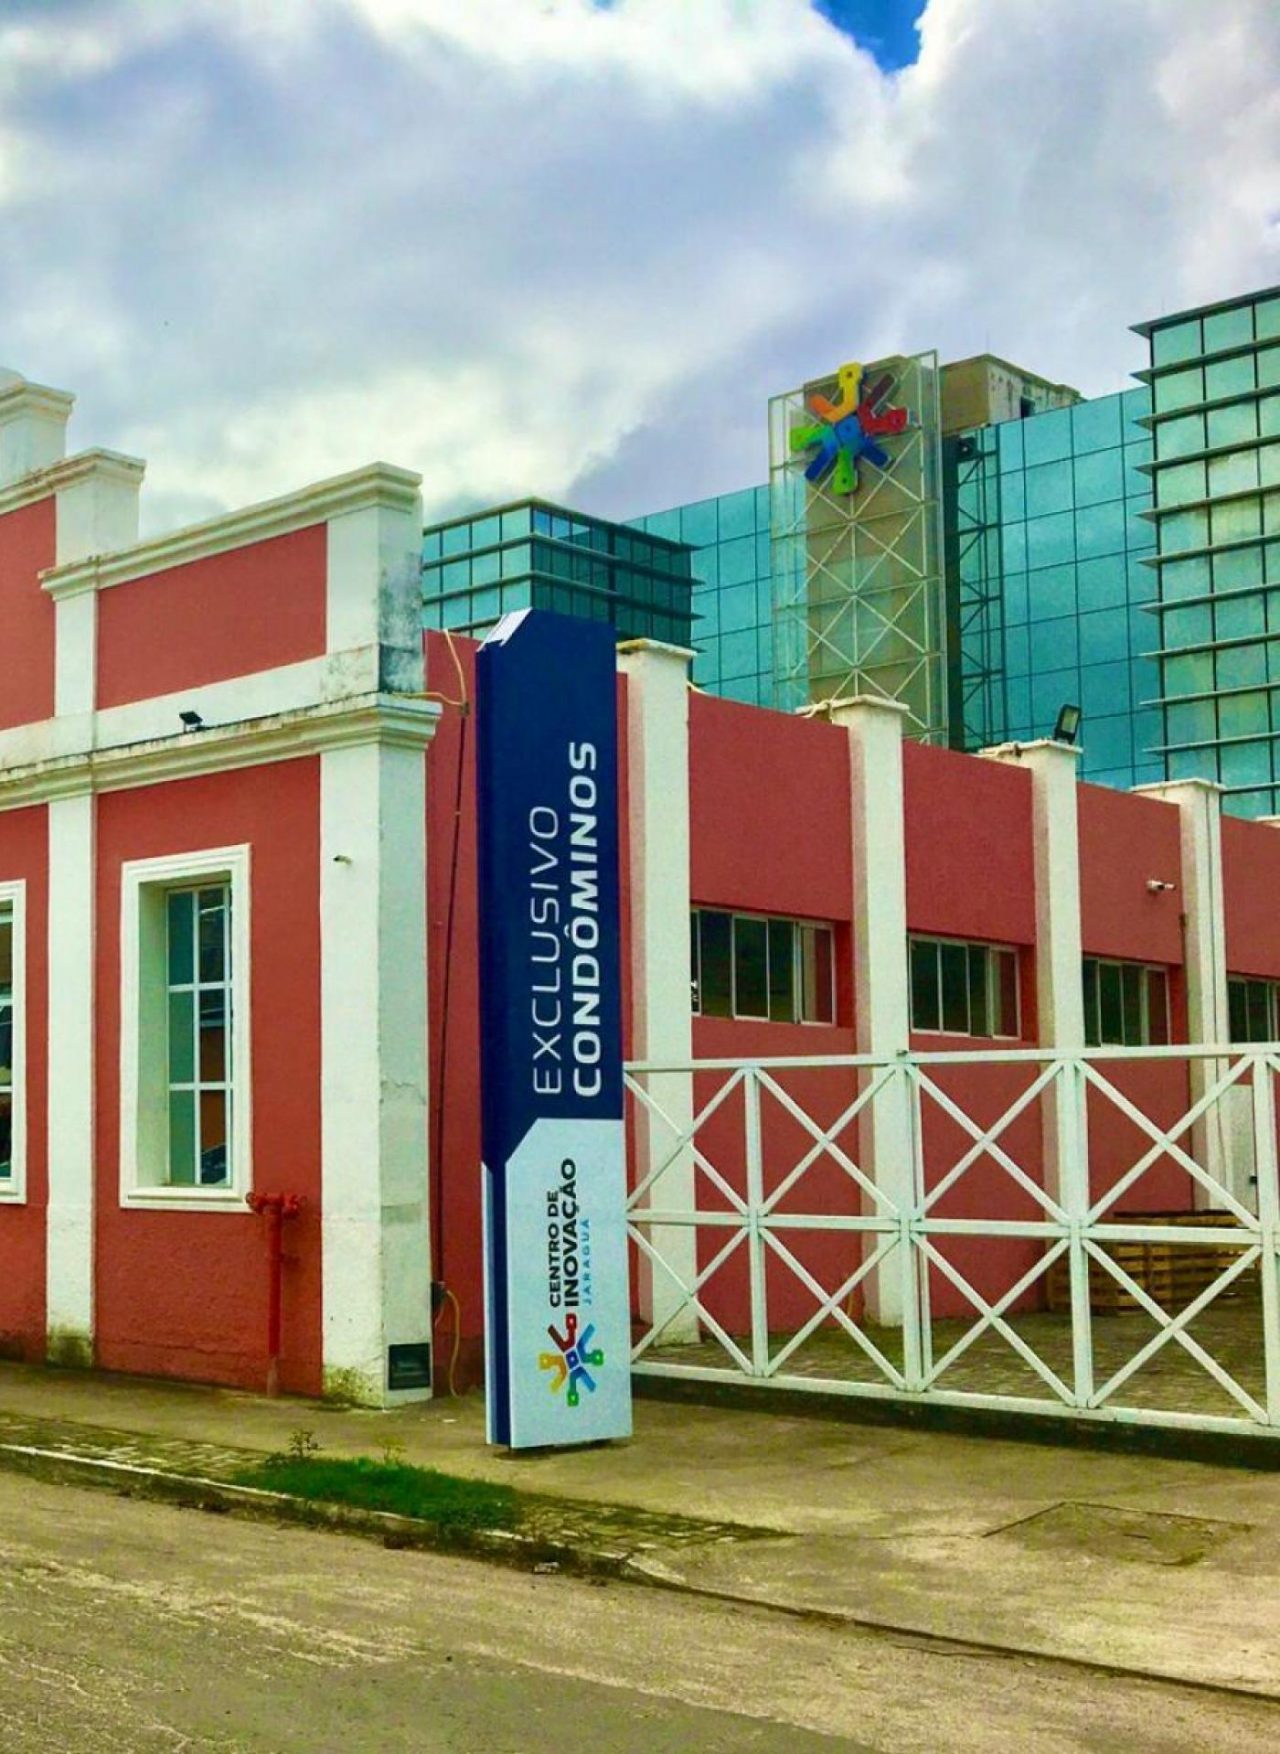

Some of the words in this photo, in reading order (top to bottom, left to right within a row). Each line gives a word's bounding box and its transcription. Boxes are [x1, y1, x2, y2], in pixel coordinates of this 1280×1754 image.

[529, 806, 562, 1094] EXCLUSIVO
[564, 741, 602, 1097] CONDÔMINOS
[547, 1190, 559, 1217] DE
[548, 1223, 561, 1308] CENTRO
[560, 1158, 580, 1307] INOVAÇÃO
